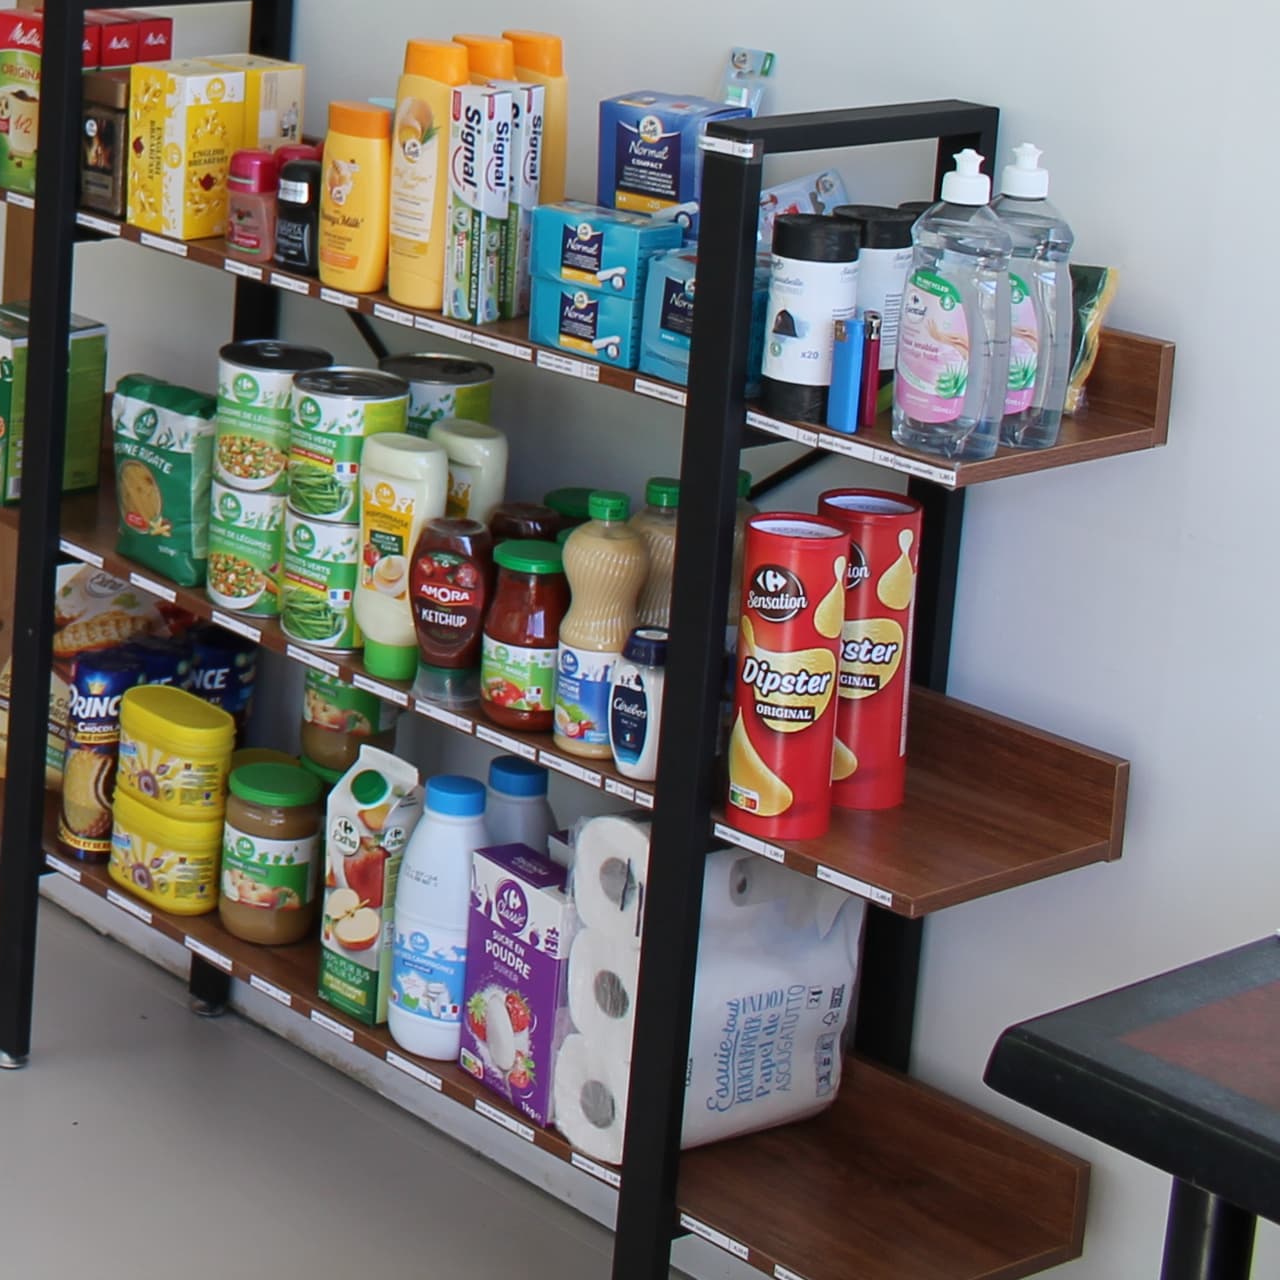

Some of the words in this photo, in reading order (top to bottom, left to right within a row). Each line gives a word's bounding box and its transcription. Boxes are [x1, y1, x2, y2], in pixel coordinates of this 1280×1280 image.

[1, 63, 41, 81] ORIGINA
[460, 105, 482, 188] Signal
[493, 121, 510, 187] Signal
[528, 115, 542, 181] Signal
[628, 139, 670, 161] Normal
[631, 158, 664, 170] COMPACT
[566, 236, 599, 256] Normal
[669, 291, 694, 310] Norm
[563, 304, 595, 324] Normal
[800, 350, 820, 361] x20
[139, 447, 174, 475] RIGATE
[420, 583, 470, 603] AMORA
[747, 589, 808, 611] Sensation
[421, 607, 468, 628] KETCHUP
[841, 638, 898, 664] ster
[190, 668, 230, 690] NCE
[742, 656, 832, 697] Dipster
[840, 674, 876, 689] GINAL
[67, 683, 122, 719] PRINC
[756, 703, 812, 721] ORIGINAL
[77, 721, 120, 733] CHOCOLA
[492, 929, 515, 950] SUCRE
[514, 943, 525, 958] EN
[485, 939, 532, 980] POUDRE
[762, 1013, 781, 1037] de
[775, 984, 806, 1092] ASCIUGATUTTO
[706, 998, 741, 1112] Essuie-tout
[735, 1016, 762, 1104] KEUKENPAPIER
[755, 1040, 776, 1098] Papel
